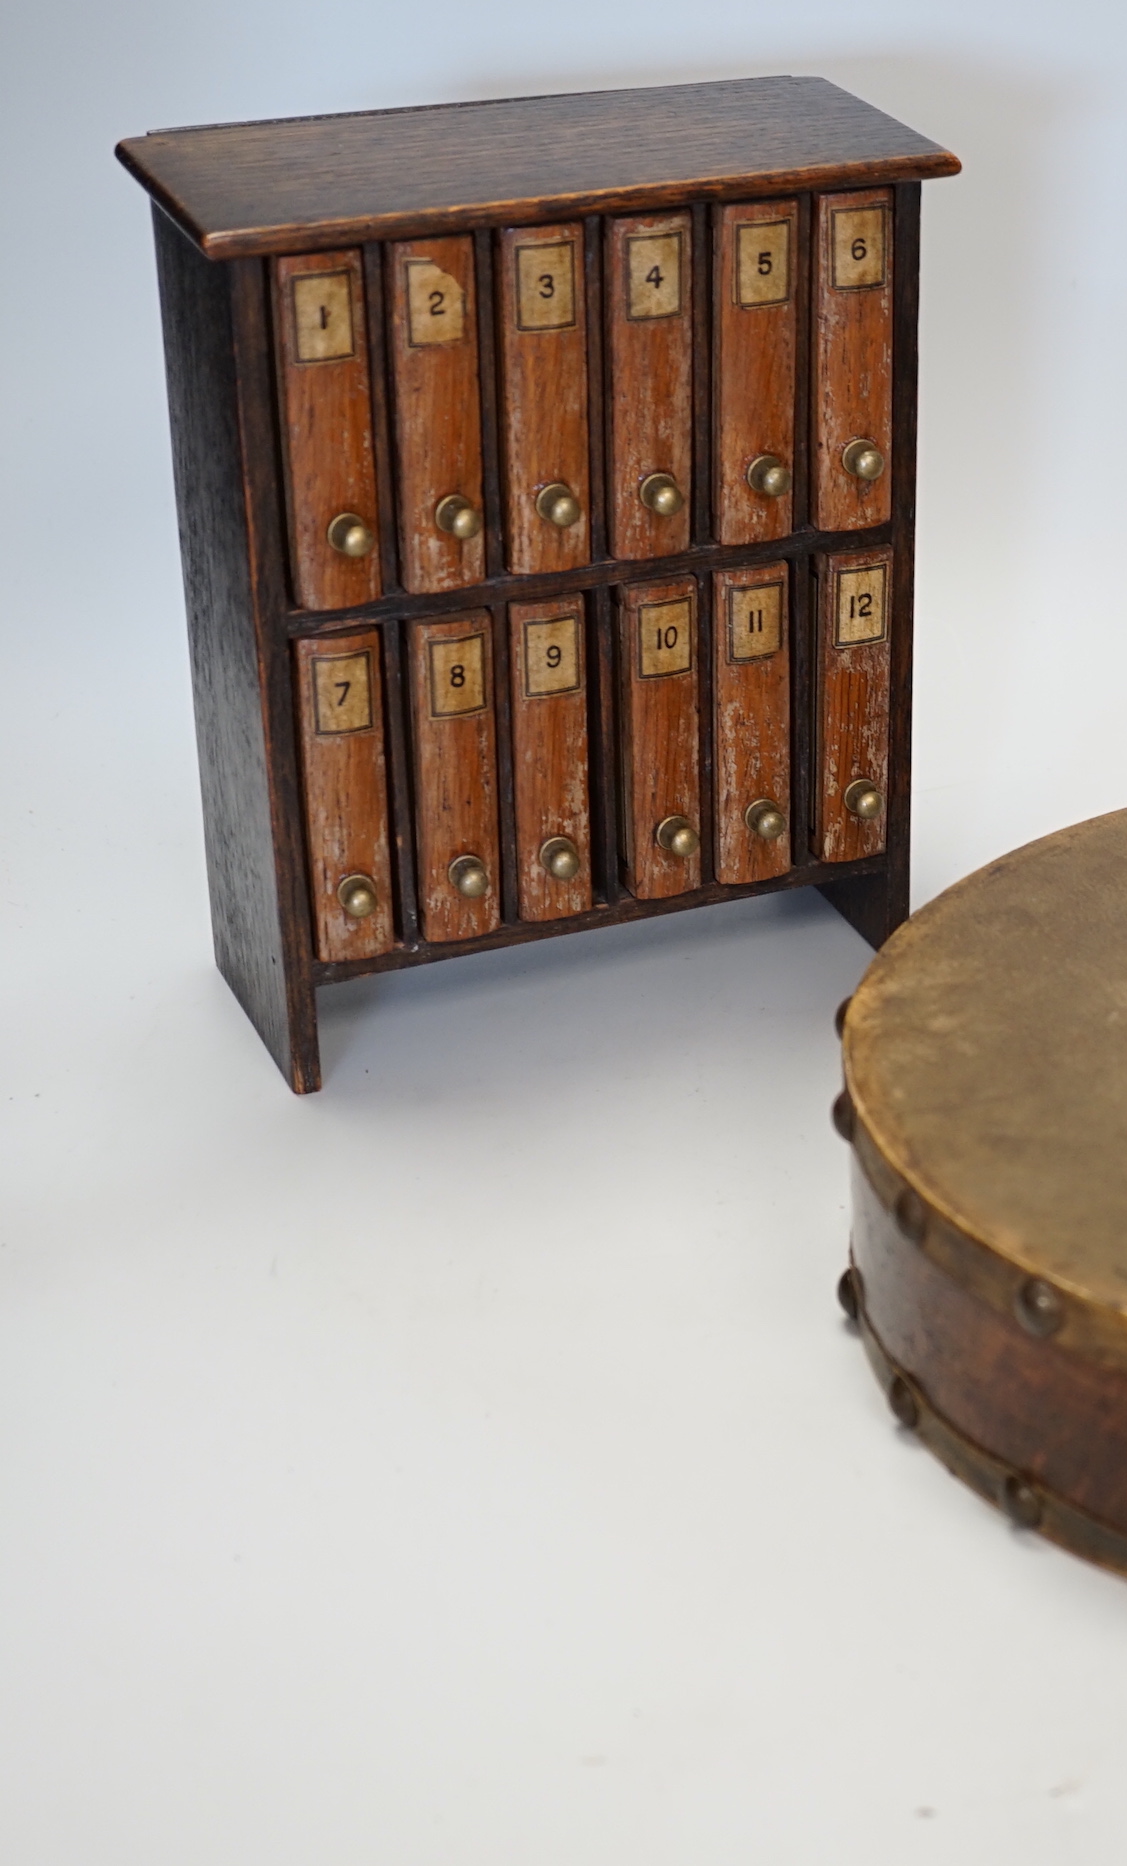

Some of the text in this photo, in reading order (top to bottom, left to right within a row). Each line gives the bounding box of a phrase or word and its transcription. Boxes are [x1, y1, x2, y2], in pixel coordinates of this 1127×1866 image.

[850, 237, 868, 261] 6
[757, 251, 773, 276] 5
[538, 273, 555, 299] 3
[645, 265, 665, 290] 4
[428, 289, 446, 317] 2
[319, 304, 332, 331] 1
[849, 592, 873, 620] 12
[748, 609, 763, 634] 11
[656, 625, 679, 651] 10
[546, 644, 562, 669] 9
[450, 664, 466, 689] 8
[334, 680, 352, 707] 7
